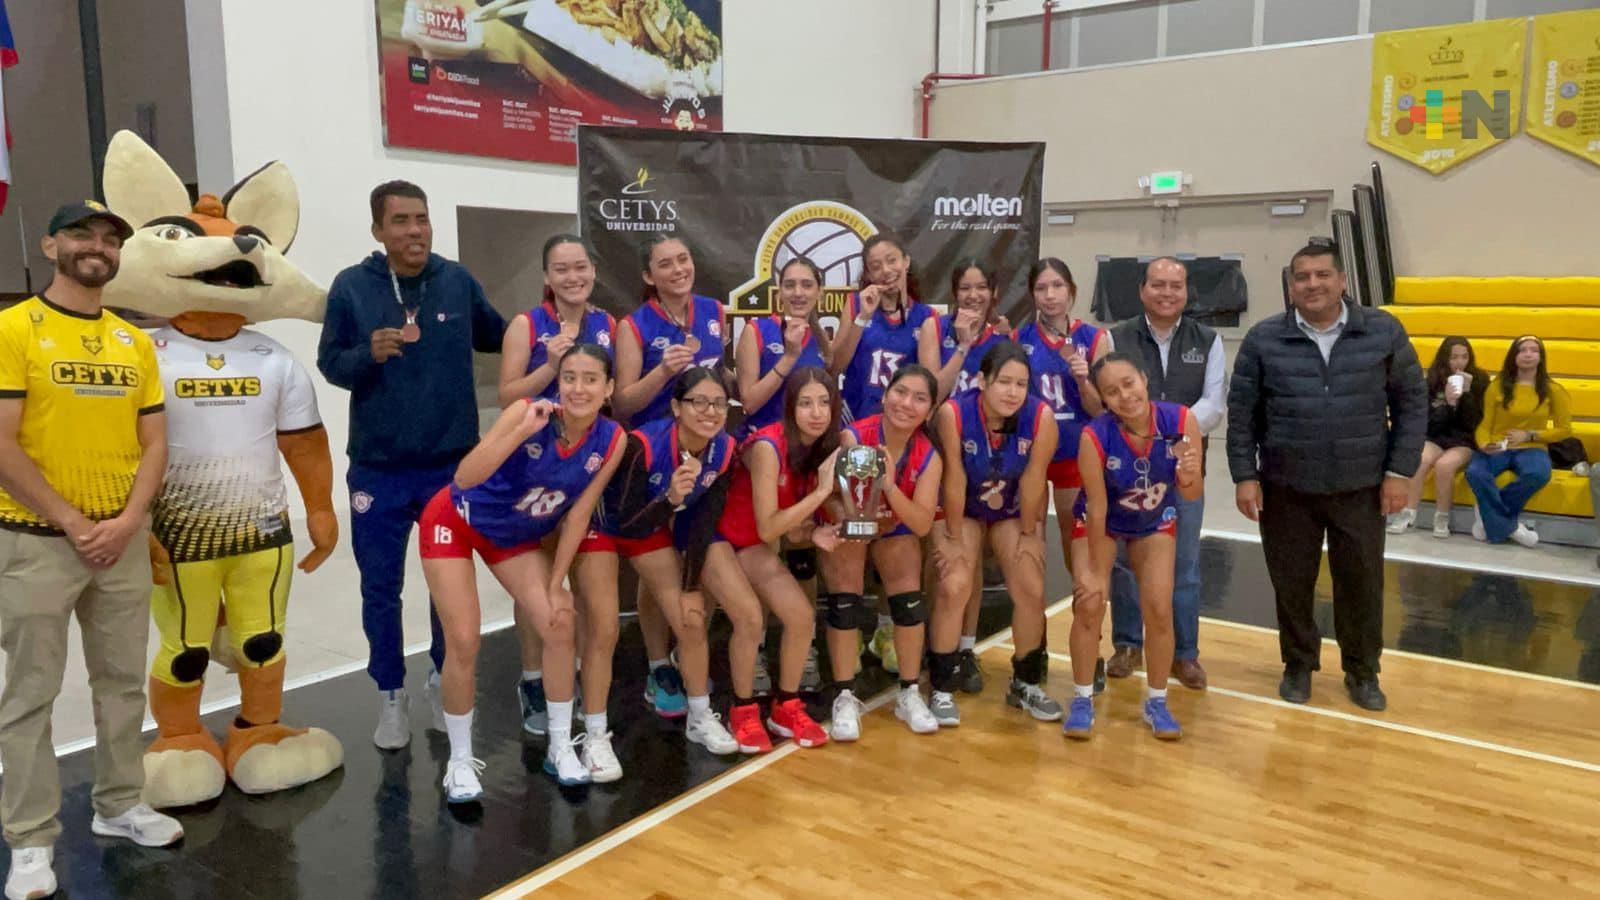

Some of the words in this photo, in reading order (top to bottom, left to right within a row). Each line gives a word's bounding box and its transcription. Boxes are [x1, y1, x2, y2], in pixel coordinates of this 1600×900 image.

[600, 199, 677, 220] CETYS
[934, 193, 1022, 216] molten
[606, 221, 675, 231] UNIVERSIDAD
[931, 219, 949, 231] For
[950, 219, 967, 230] the
[969, 219, 992, 230] real
[53, 363, 138, 387] CETYS
[176, 378, 260, 397] CETYS
[515, 487, 566, 517] 18
[434, 524, 452, 544] 18
